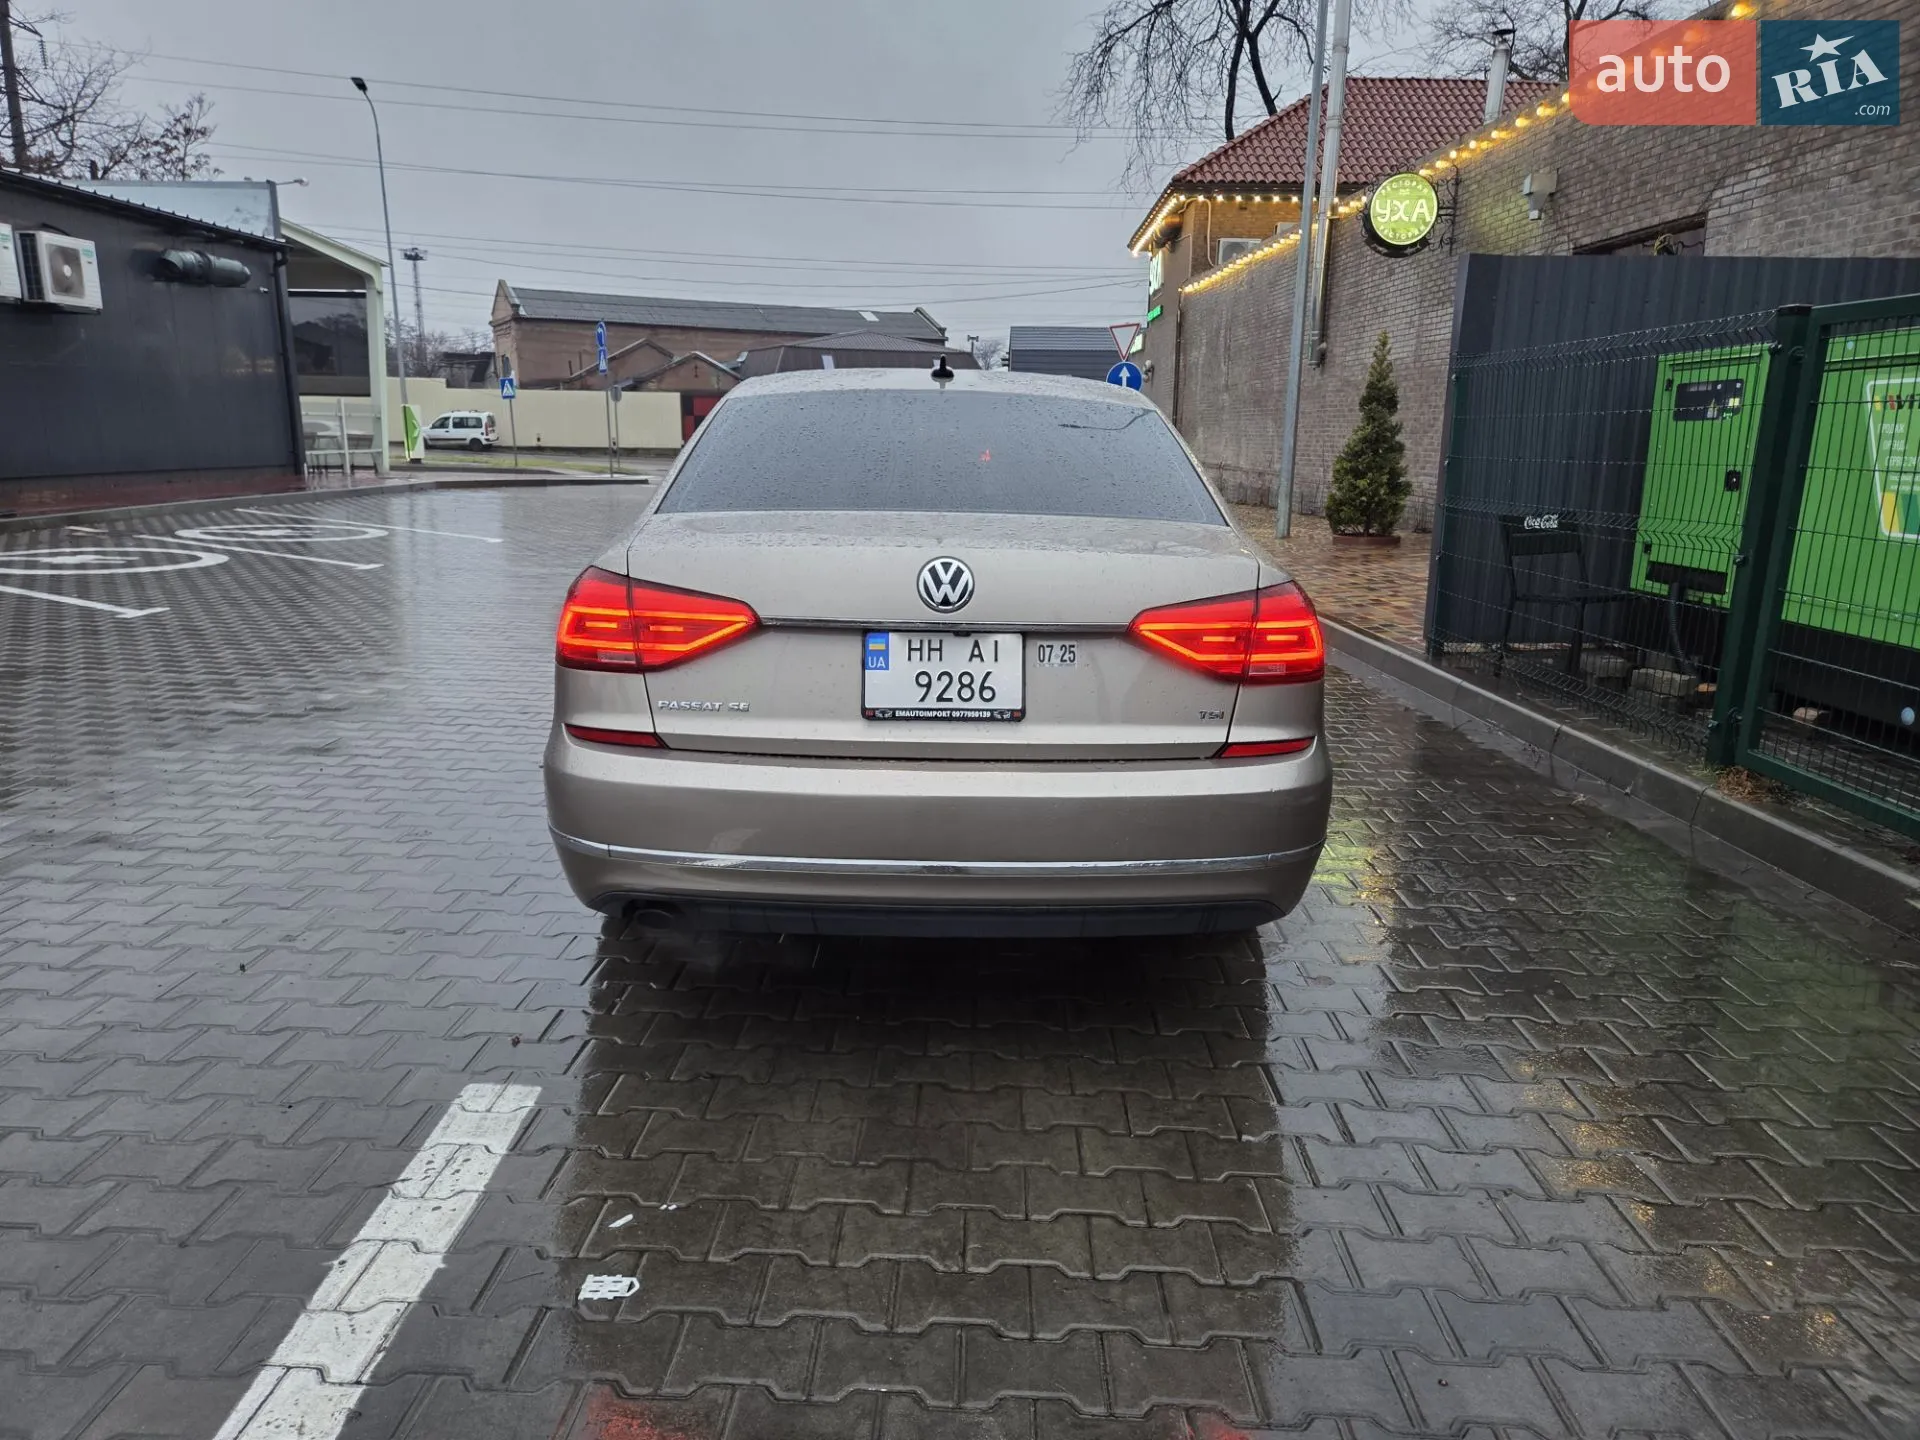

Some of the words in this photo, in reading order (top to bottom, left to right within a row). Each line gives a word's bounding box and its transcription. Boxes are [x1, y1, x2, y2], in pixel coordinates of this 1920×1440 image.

[1375, 198, 1431, 223] УХА
[1524, 514, 1559, 530] Coca-Cola
[907, 639, 943, 662] HH
[969, 639, 999, 662] AI
[868, 656, 886, 669] UA
[914, 670, 997, 703] 9286
[657, 700, 723, 712] PASSAT
[728, 701, 750, 712] SE
